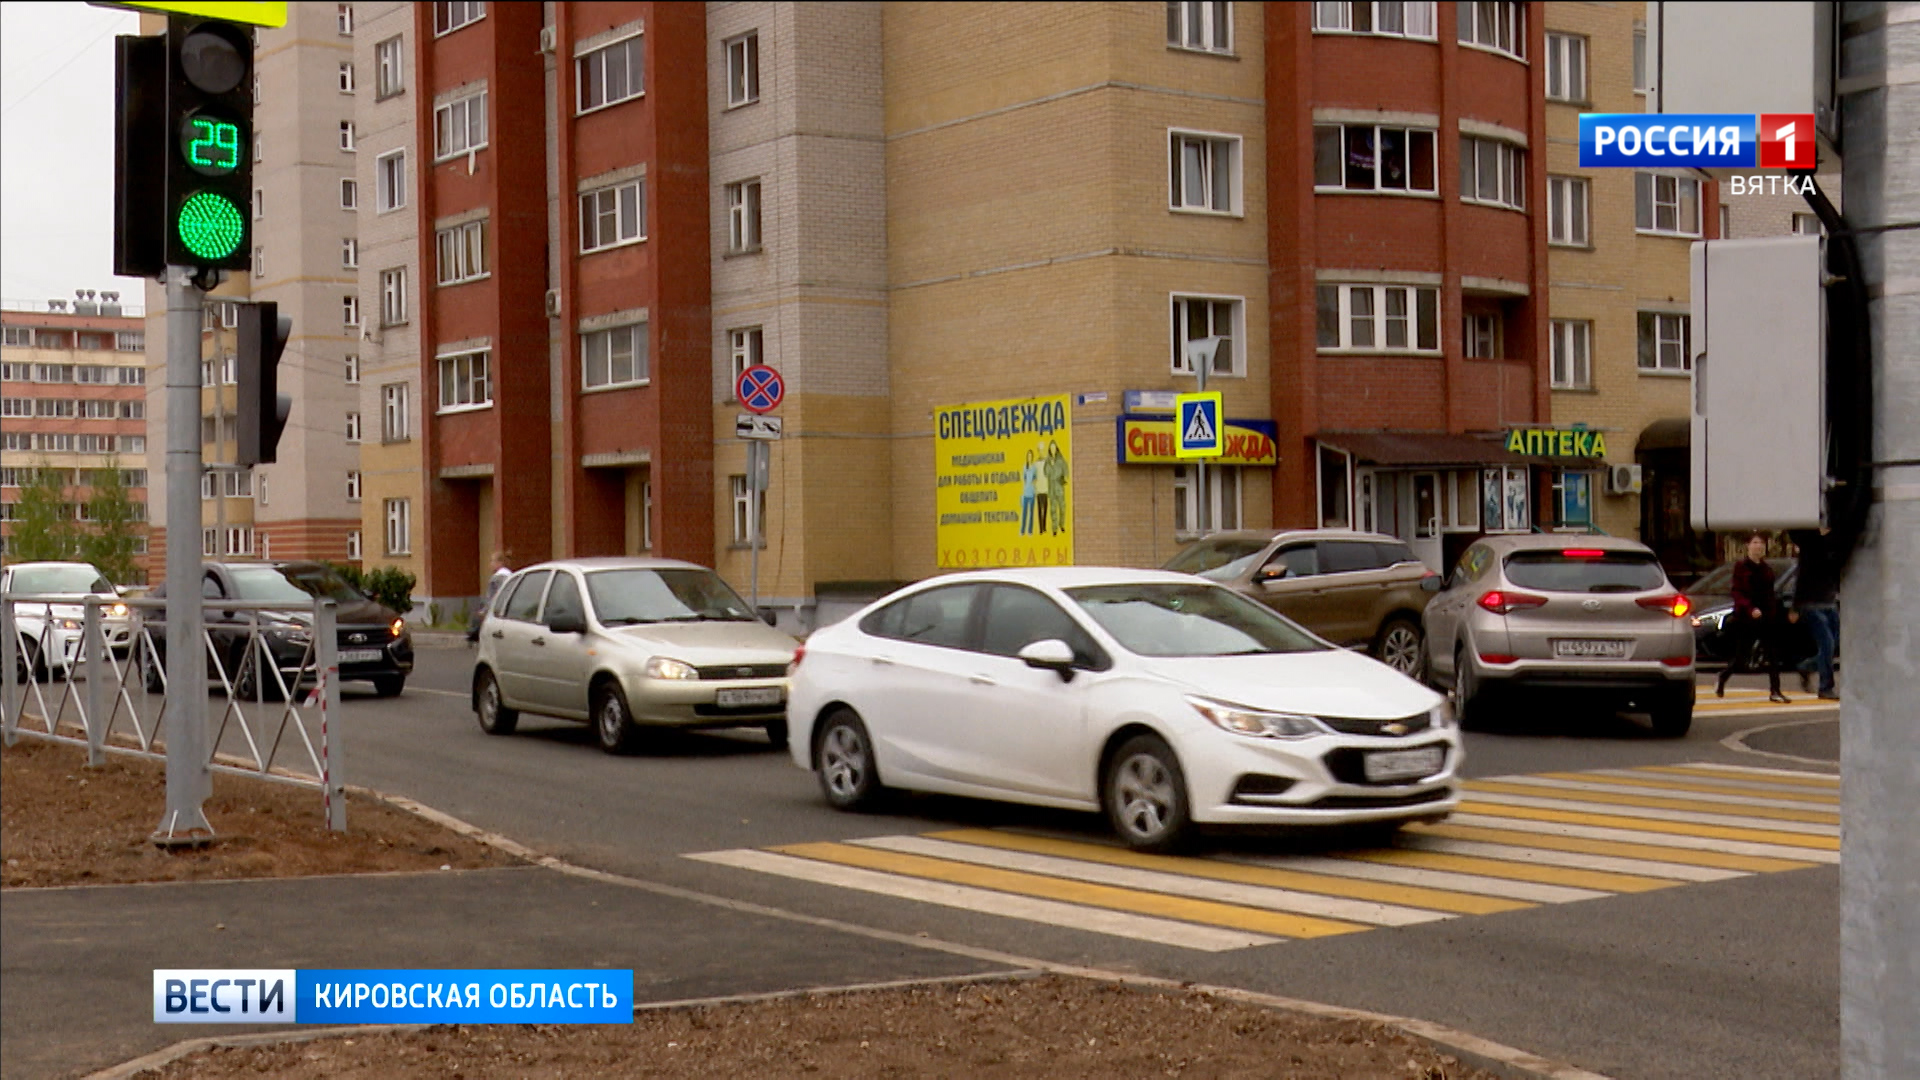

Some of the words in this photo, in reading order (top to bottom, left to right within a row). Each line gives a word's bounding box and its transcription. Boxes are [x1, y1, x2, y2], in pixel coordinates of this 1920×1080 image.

[189, 118, 239, 169] 29
[939, 400, 1066, 441] СПЕЦОДЕЖДА
[1128, 427, 1274, 462] СПЕЖДА
[1507, 428, 1607, 458] АПТЕКА
[937, 474, 952, 488] ДЛЯ
[953, 473, 982, 486] РАБОТЫ
[984, 473, 989, 484] И
[942, 547, 1068, 565] ХОЗТОВАРЫ
